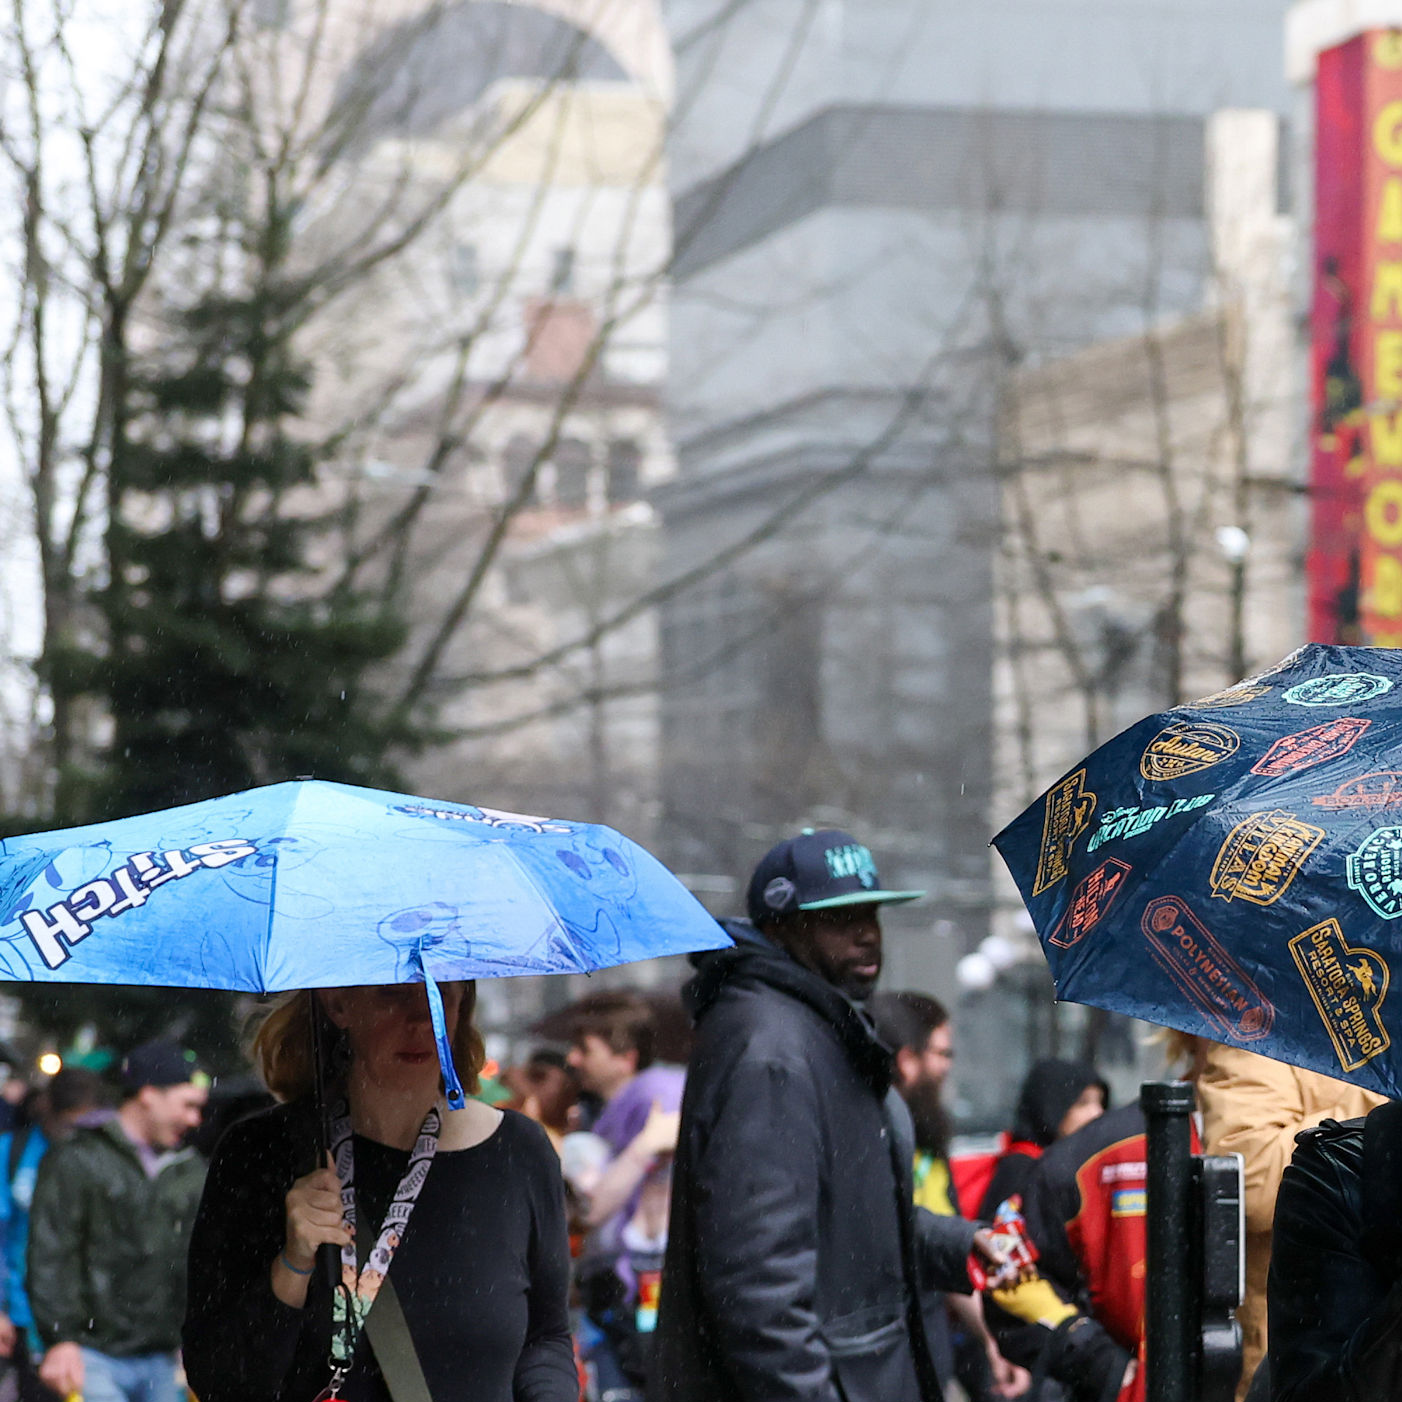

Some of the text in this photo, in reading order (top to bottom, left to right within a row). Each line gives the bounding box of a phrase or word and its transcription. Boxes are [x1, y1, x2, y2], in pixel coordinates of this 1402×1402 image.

[1242, 825, 1295, 888] KINGDOM
[1260, 835, 1304, 886] ANIMAL
[1365, 830, 1395, 912] VERO BEACH
[1381, 850, 1393, 883] RESORT
[1171, 924, 1250, 1010] POLYNESIAN
[1307, 950, 1357, 1047] RESORT & SPA
[1309, 925, 1383, 1055] SARATOGA SPRINGS
